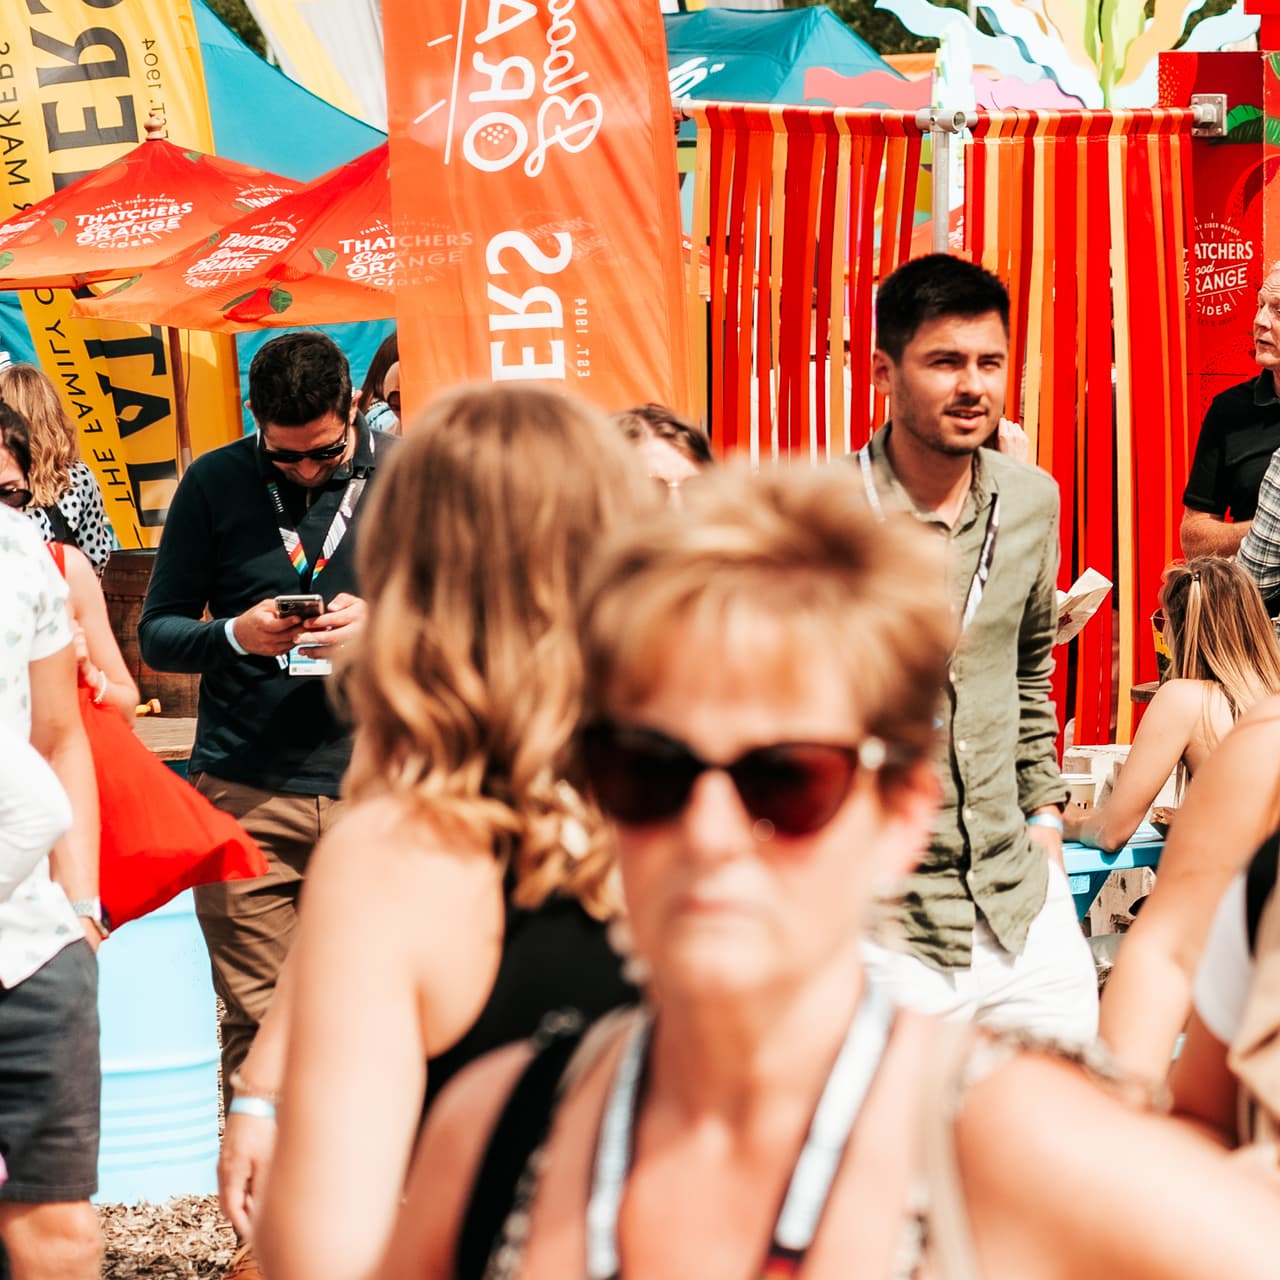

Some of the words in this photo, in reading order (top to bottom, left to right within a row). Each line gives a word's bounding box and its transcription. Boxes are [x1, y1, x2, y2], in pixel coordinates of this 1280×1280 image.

[75, 202, 193, 226] THATCHERS
[76, 217, 181, 246] ORANGE
[338, 232, 473, 254] THATCHERS
[1184, 240, 1254, 260] ATCHERS
